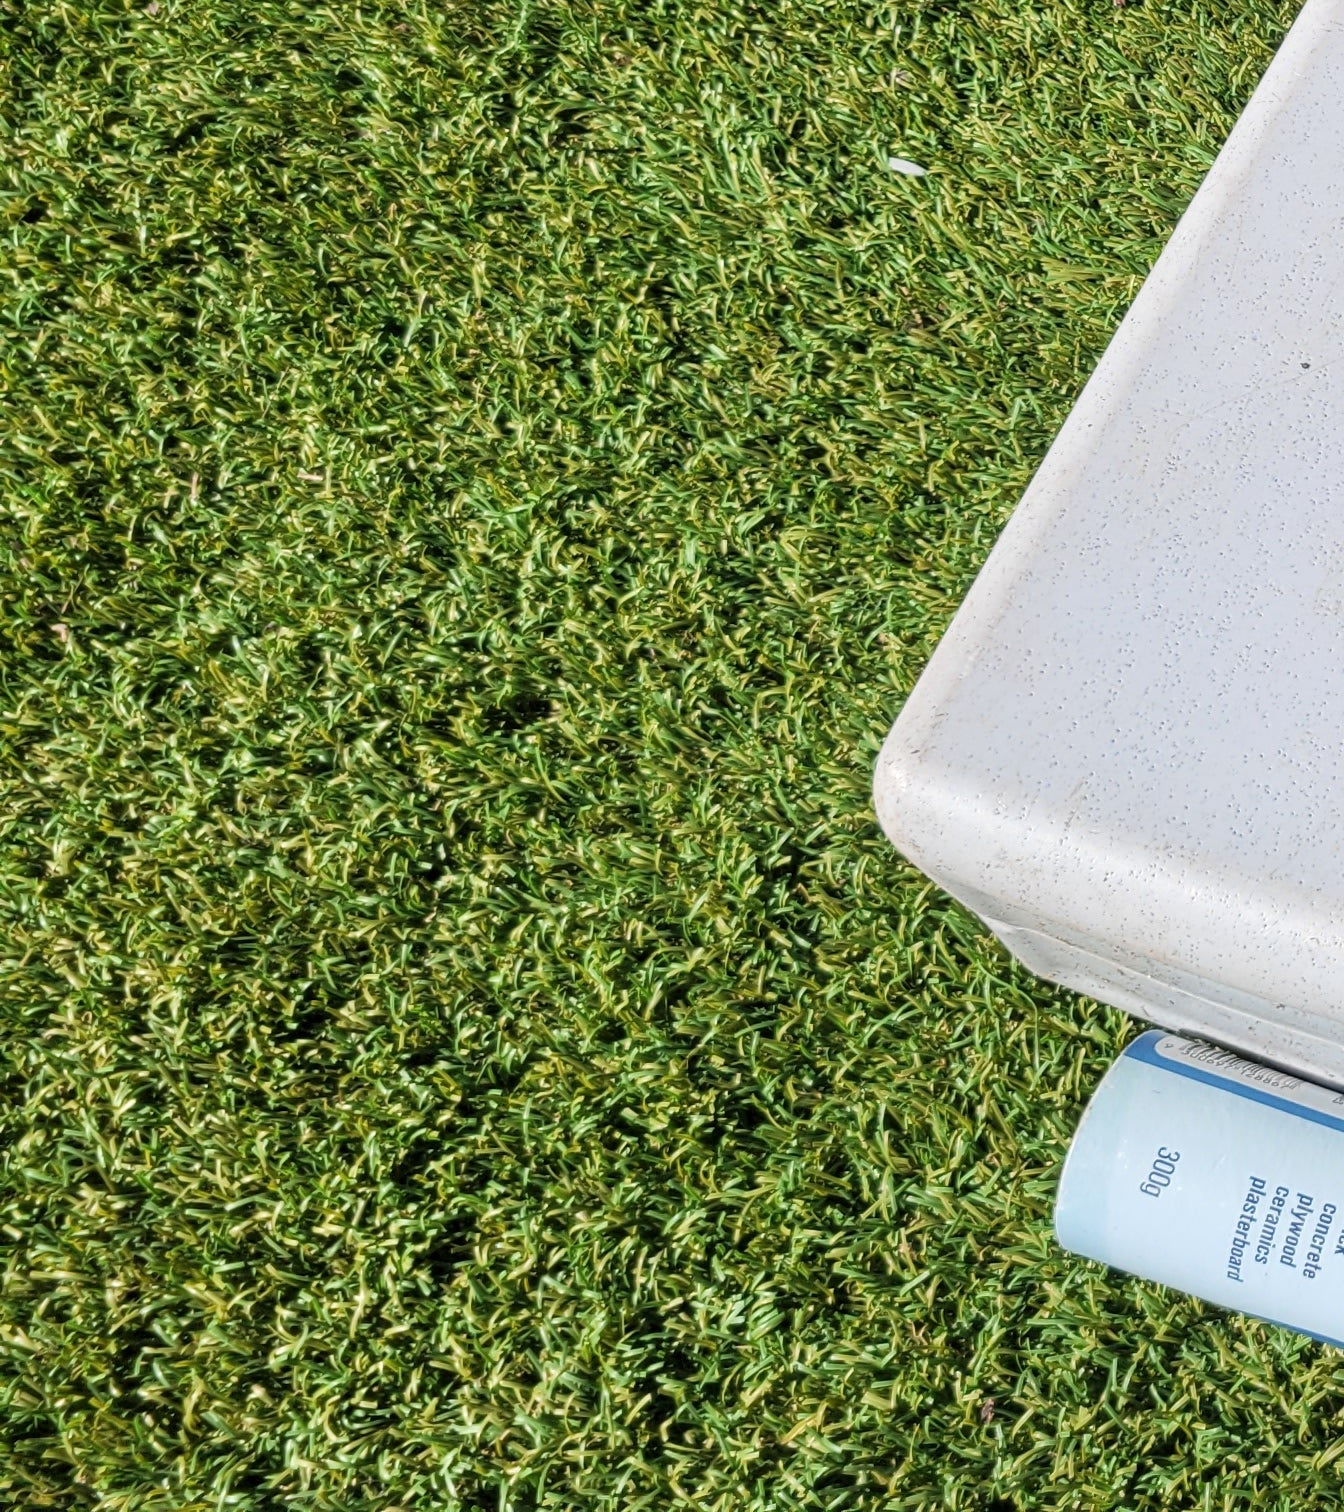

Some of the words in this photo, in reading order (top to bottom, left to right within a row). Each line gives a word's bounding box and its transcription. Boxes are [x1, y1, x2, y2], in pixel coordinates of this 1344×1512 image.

[1140, 1146, 1181, 1198] 300g
[1227, 1175, 1267, 1283] plasterboard
[1255, 1185, 1290, 1265] ceramics
[1279, 1192, 1314, 1269] plywood
[1303, 1202, 1337, 1280] concrete
